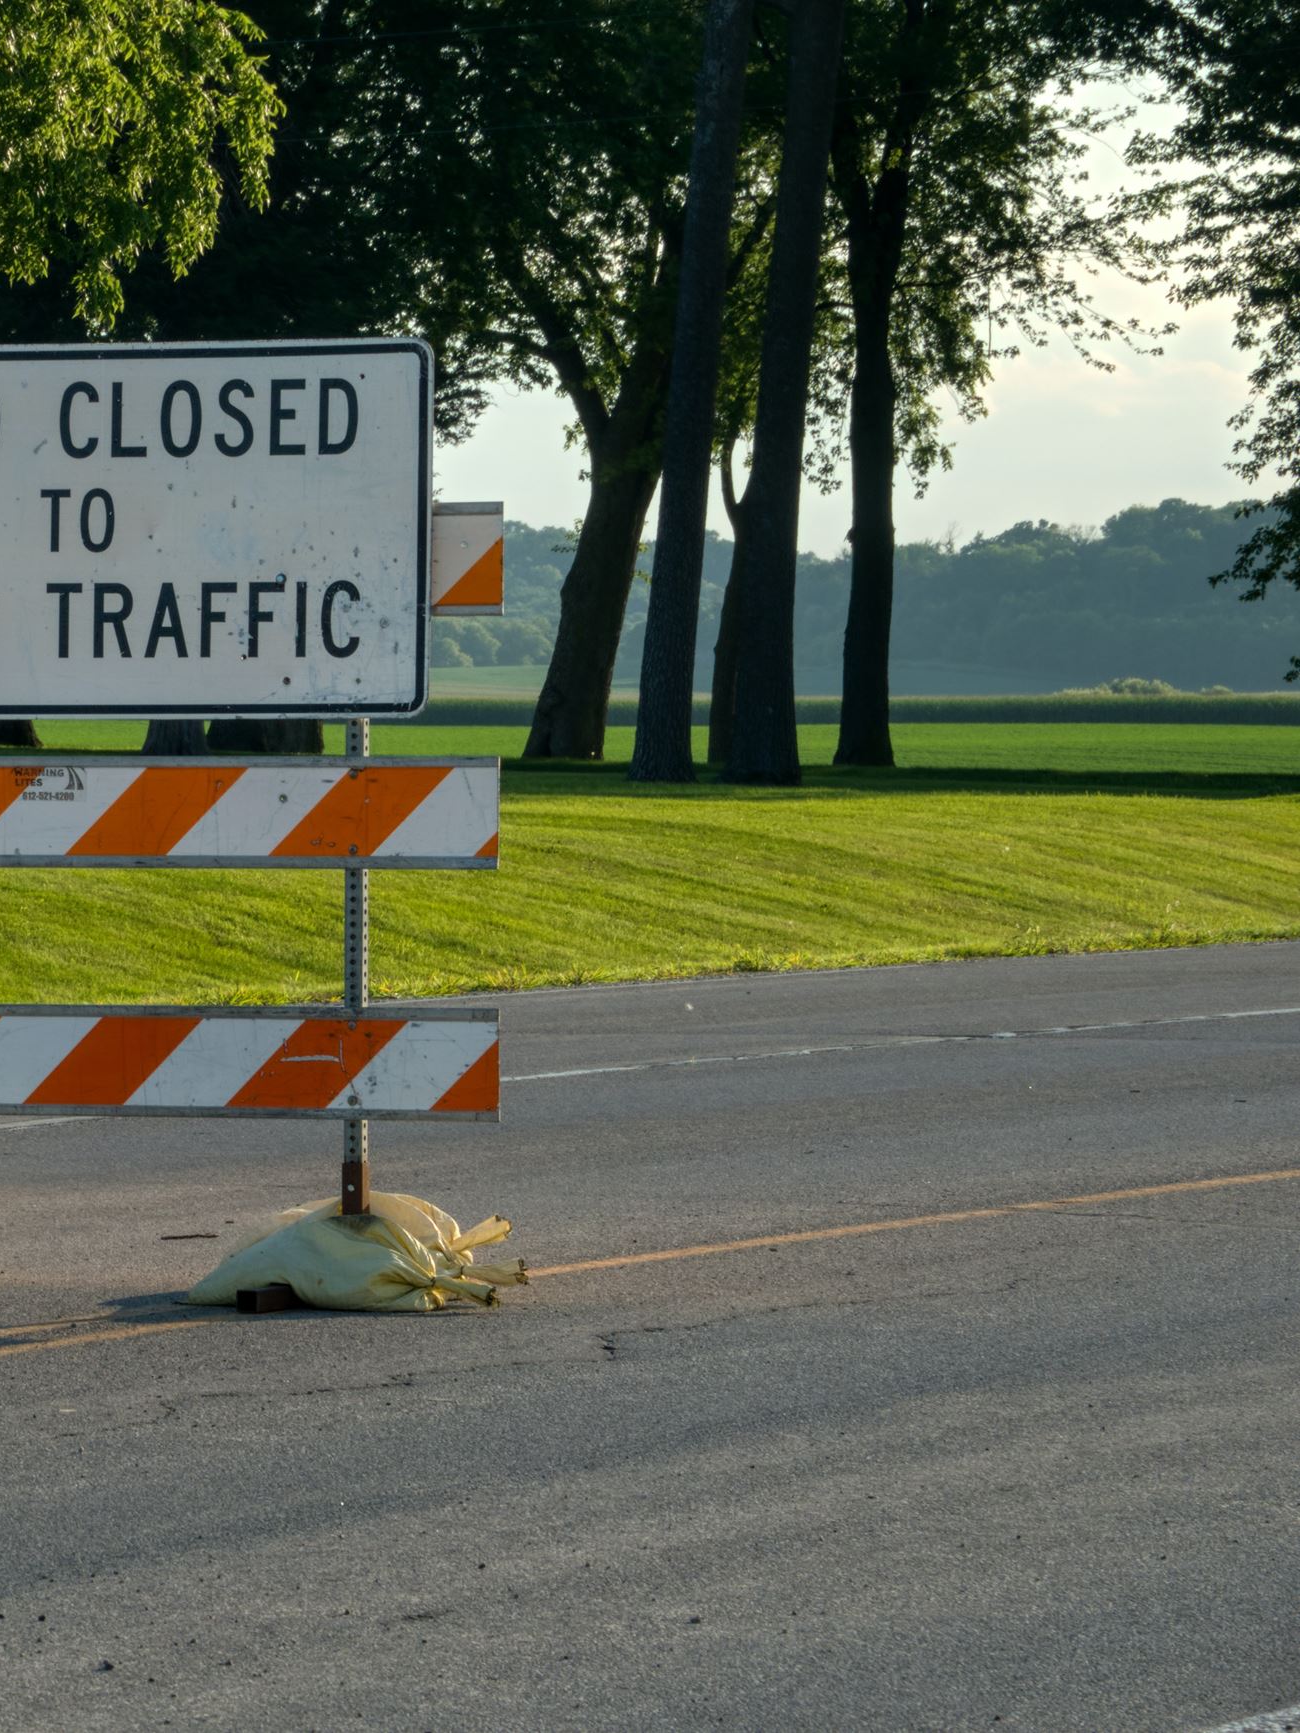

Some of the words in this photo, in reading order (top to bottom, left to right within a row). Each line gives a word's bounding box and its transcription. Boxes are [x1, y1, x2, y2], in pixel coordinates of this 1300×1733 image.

[59, 377, 359, 460] CLOSED
[40, 487, 115, 553] TO
[46, 579, 361, 659] TRAFFIC
[13, 767, 65, 777] WARNING
[14, 778, 43, 787] LITES
